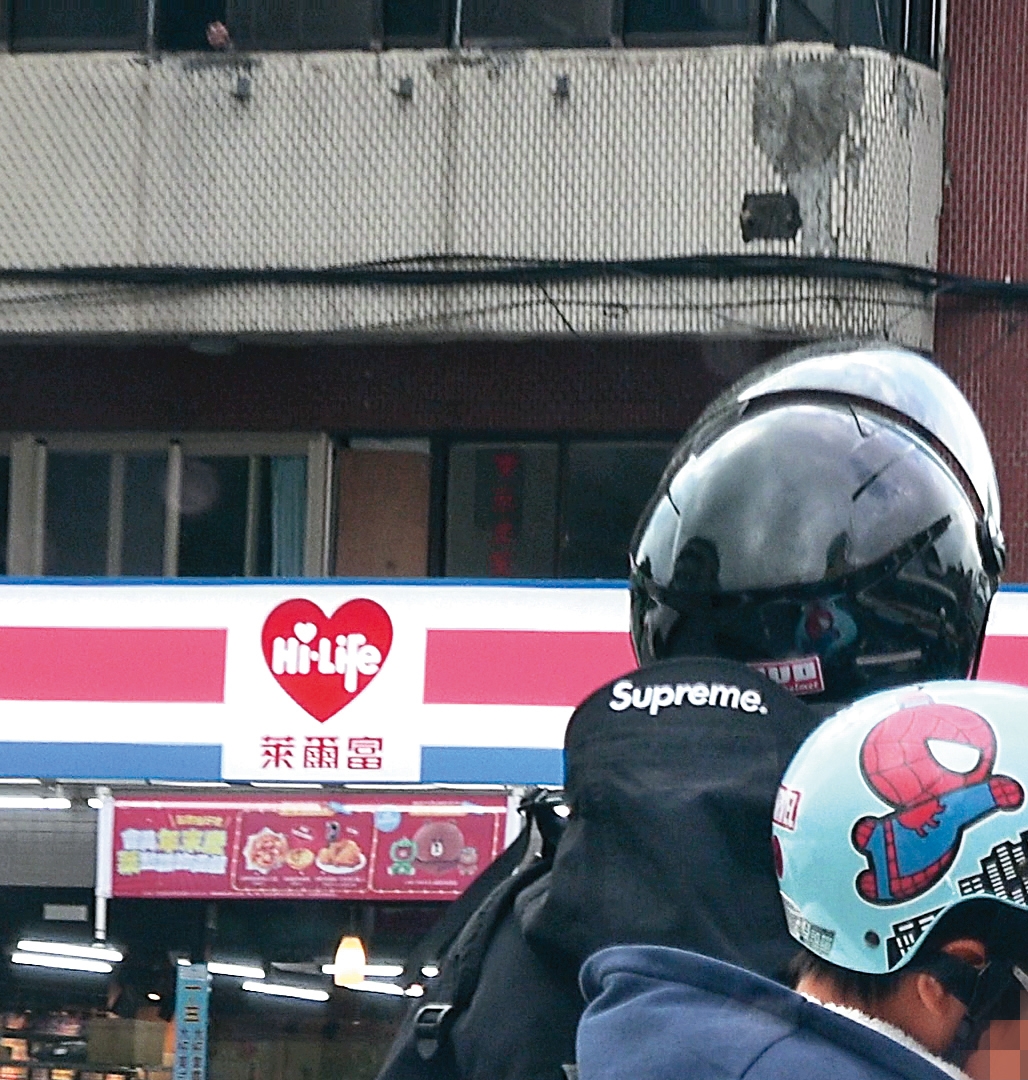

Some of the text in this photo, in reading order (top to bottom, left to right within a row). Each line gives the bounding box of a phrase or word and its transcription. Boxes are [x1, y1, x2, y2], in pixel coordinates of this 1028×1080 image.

[271, 621, 383, 693] Hi-Life
[261, 736, 383, 770] 萊爾富
